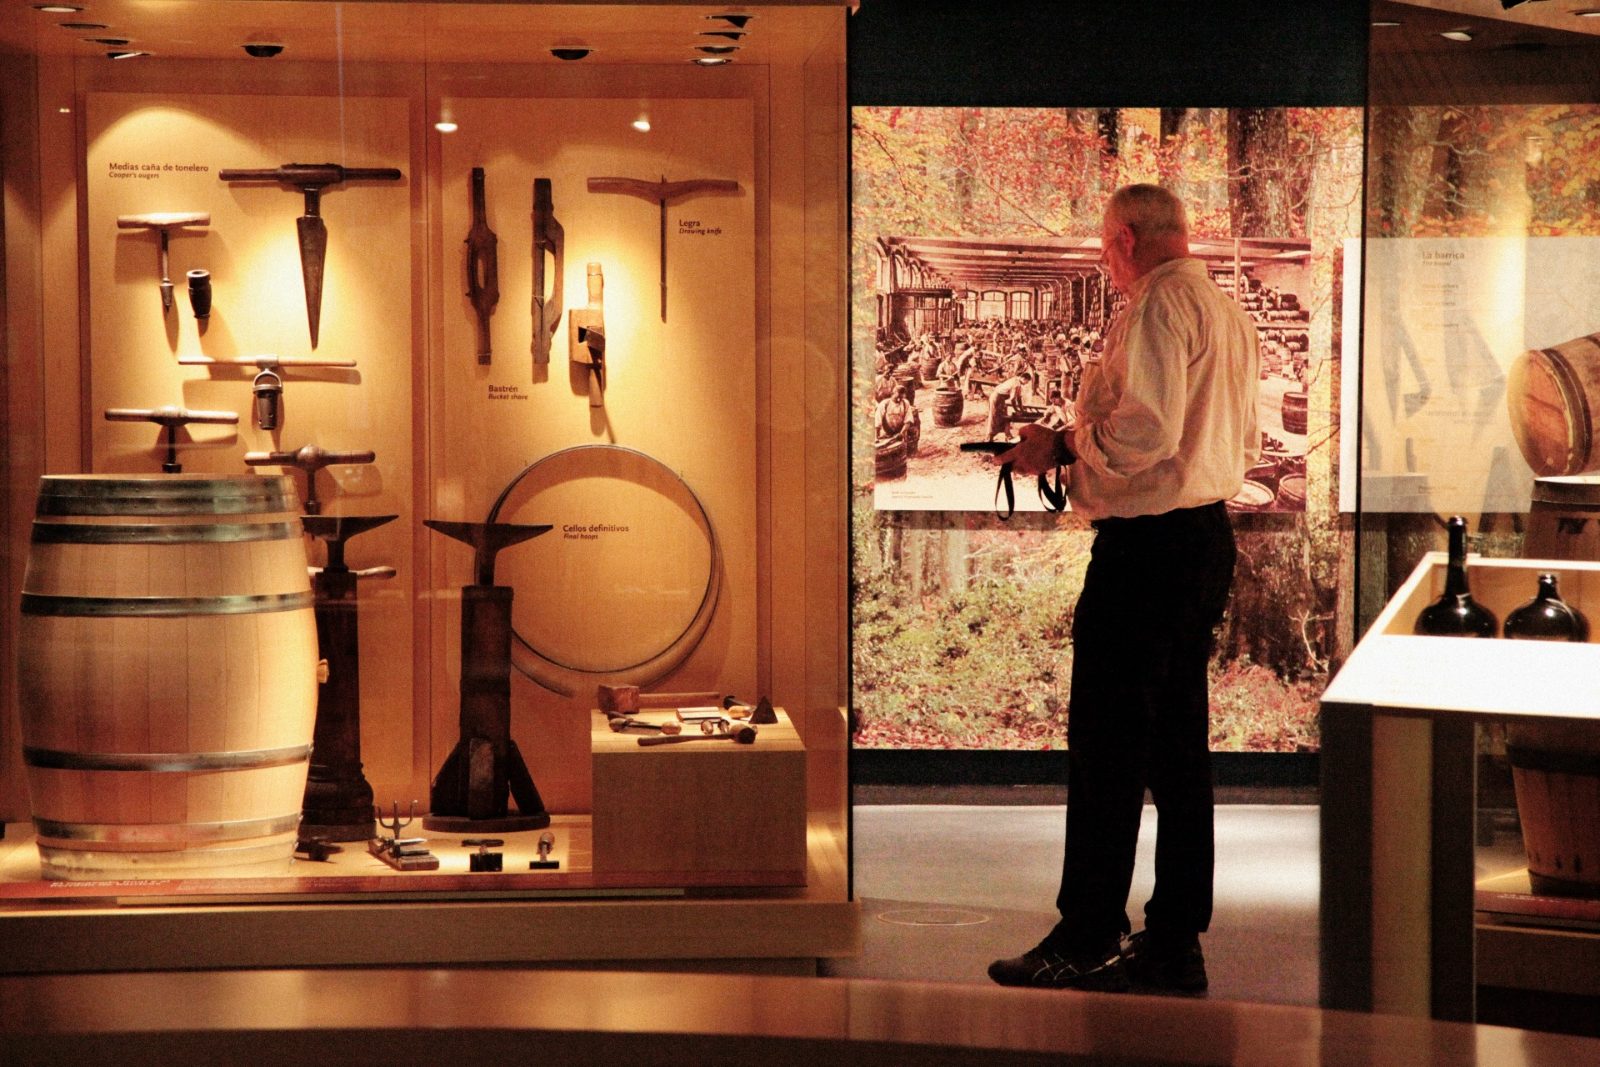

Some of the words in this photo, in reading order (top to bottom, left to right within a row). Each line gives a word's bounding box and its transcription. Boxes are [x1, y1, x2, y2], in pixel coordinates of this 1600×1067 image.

[109, 163, 138, 171] Medias
[175, 163, 209, 172] tonelero
[679, 219, 701, 229] Legra
[679, 228, 705, 236] Drawing
[707, 227, 722, 236] knife
[489, 384, 519, 393] Bastrén
[562, 524, 587, 532] Cellos
[588, 523, 629, 532] definitivos
[580, 533, 599, 541] hoops
